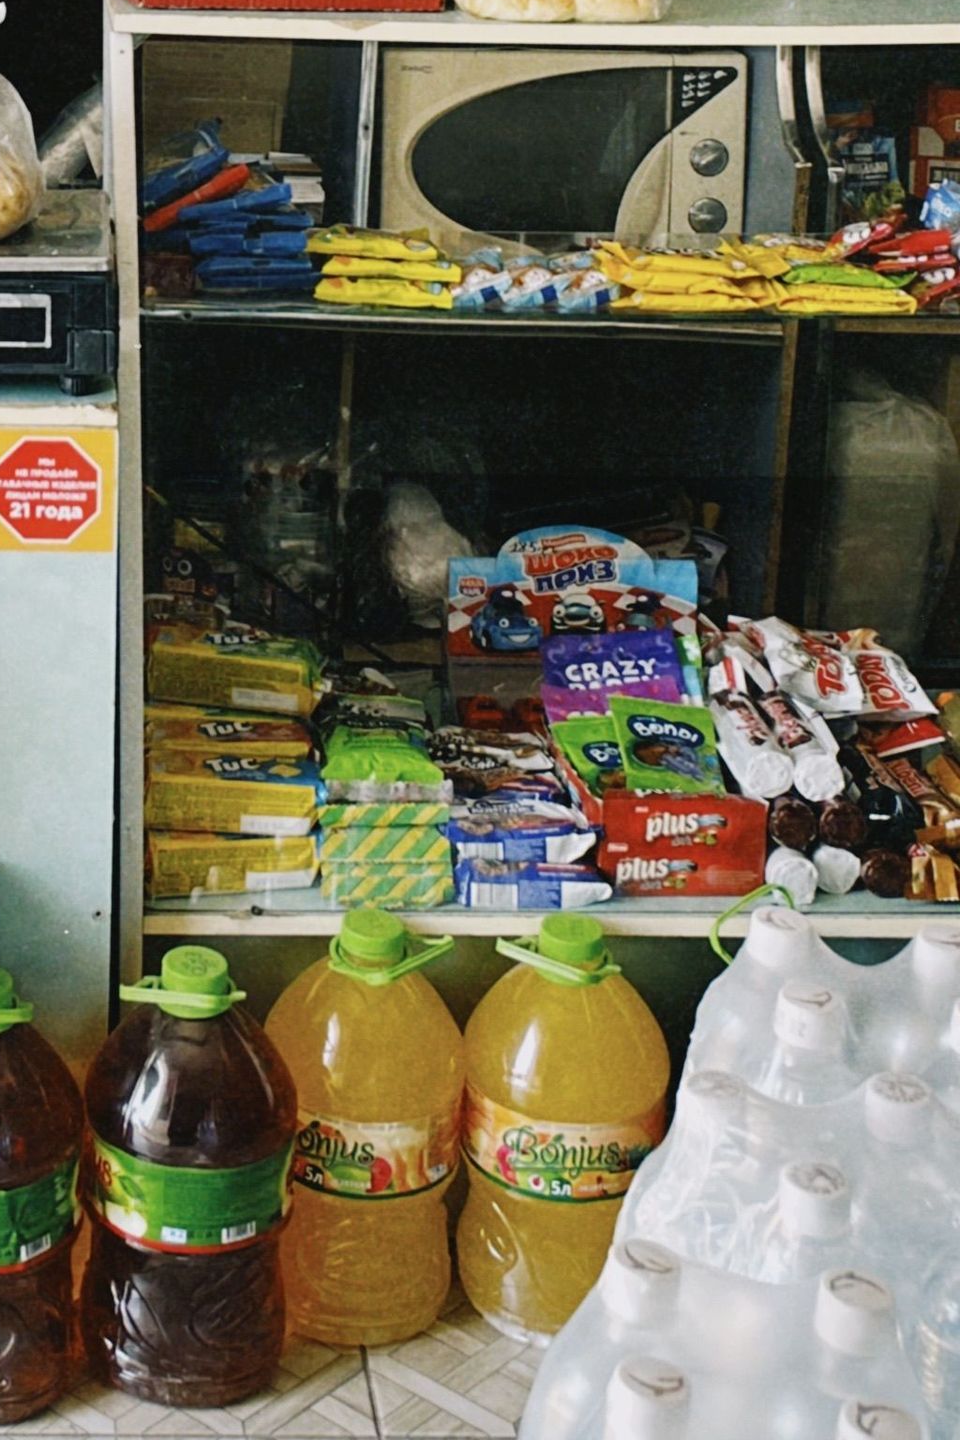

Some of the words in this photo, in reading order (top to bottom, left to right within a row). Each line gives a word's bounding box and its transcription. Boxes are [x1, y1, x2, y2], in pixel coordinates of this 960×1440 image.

[9, 502, 31, 520] 21
[33, 504, 83, 522] года
[565, 658, 657, 682] CRAZY
[632, 717, 700, 744] BONDI
[645, 812, 699, 841] plus
[617, 857, 670, 885] plus
